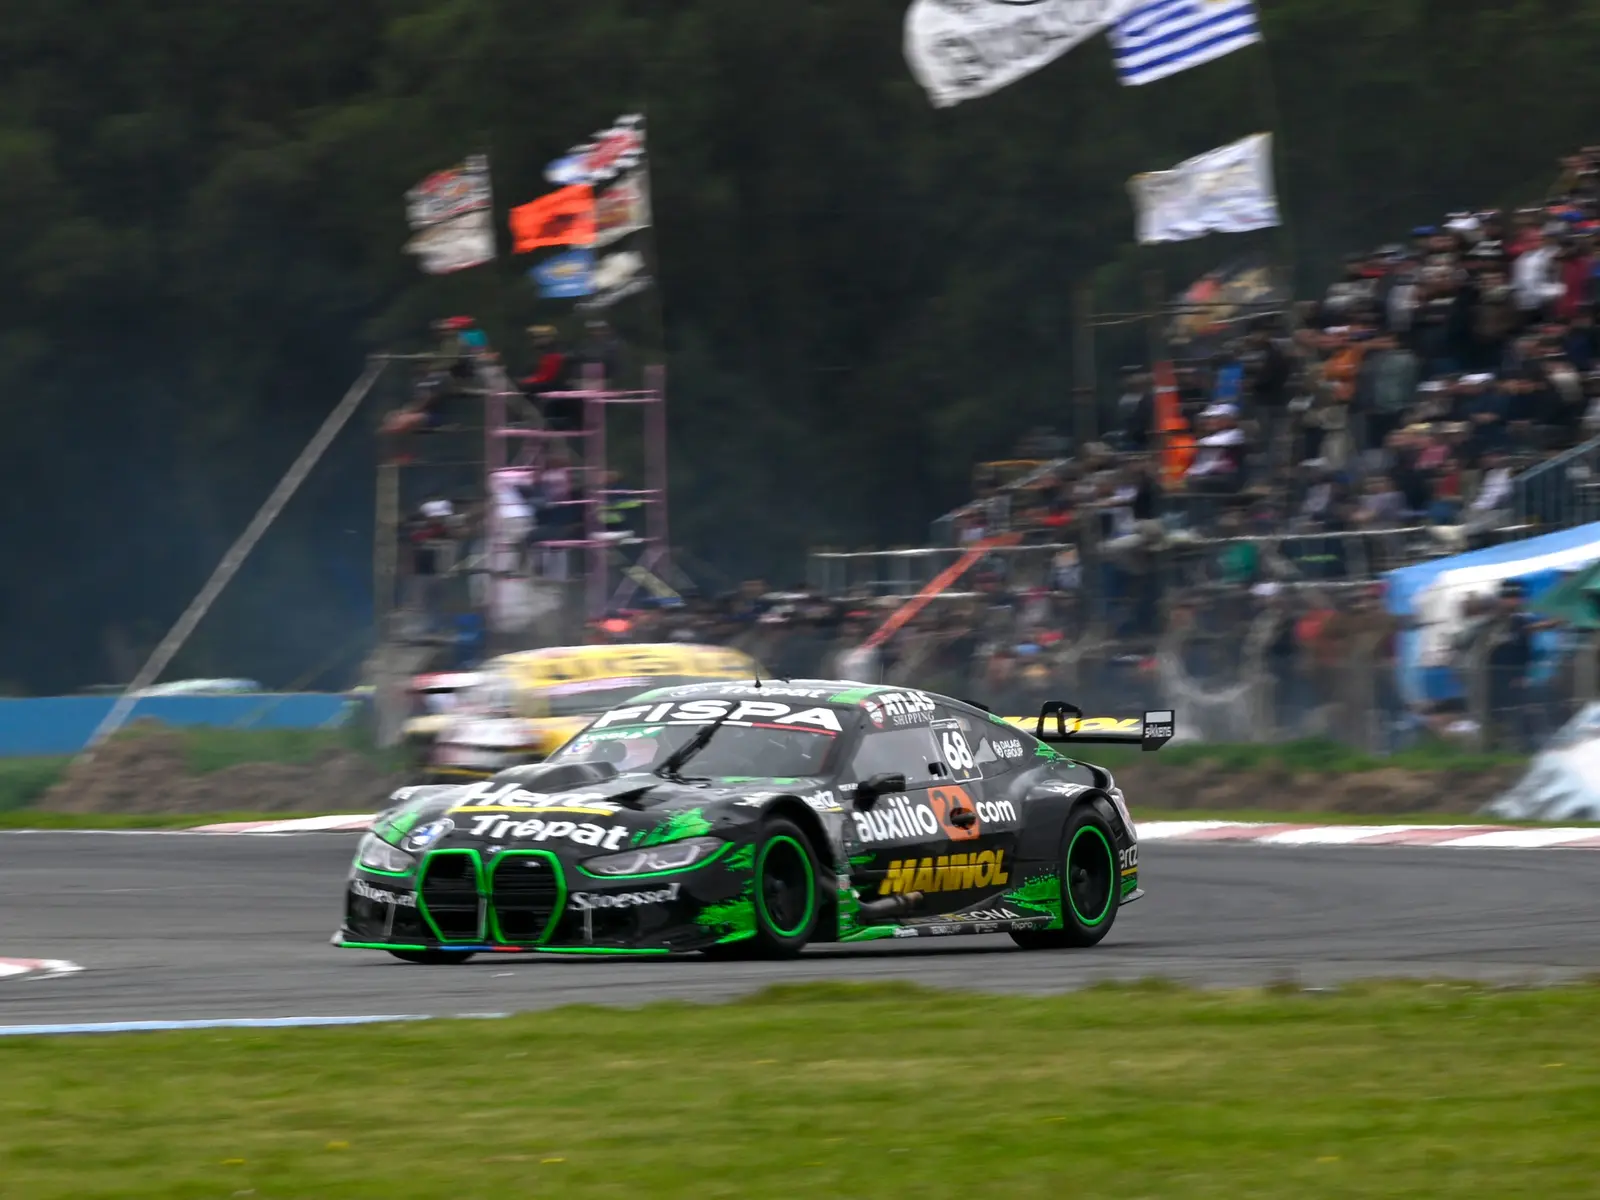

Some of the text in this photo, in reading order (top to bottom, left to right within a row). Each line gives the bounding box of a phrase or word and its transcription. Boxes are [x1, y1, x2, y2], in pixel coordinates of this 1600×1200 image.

[592, 700, 842, 731] FISPA
[878, 691, 936, 716] ATLAS
[893, 710, 935, 726] SHIPPING
[942, 731, 973, 770] 68
[1004, 746, 1024, 759] GROUP
[469, 814, 629, 850] Trepat
[878, 849, 1008, 895] MANNOL
